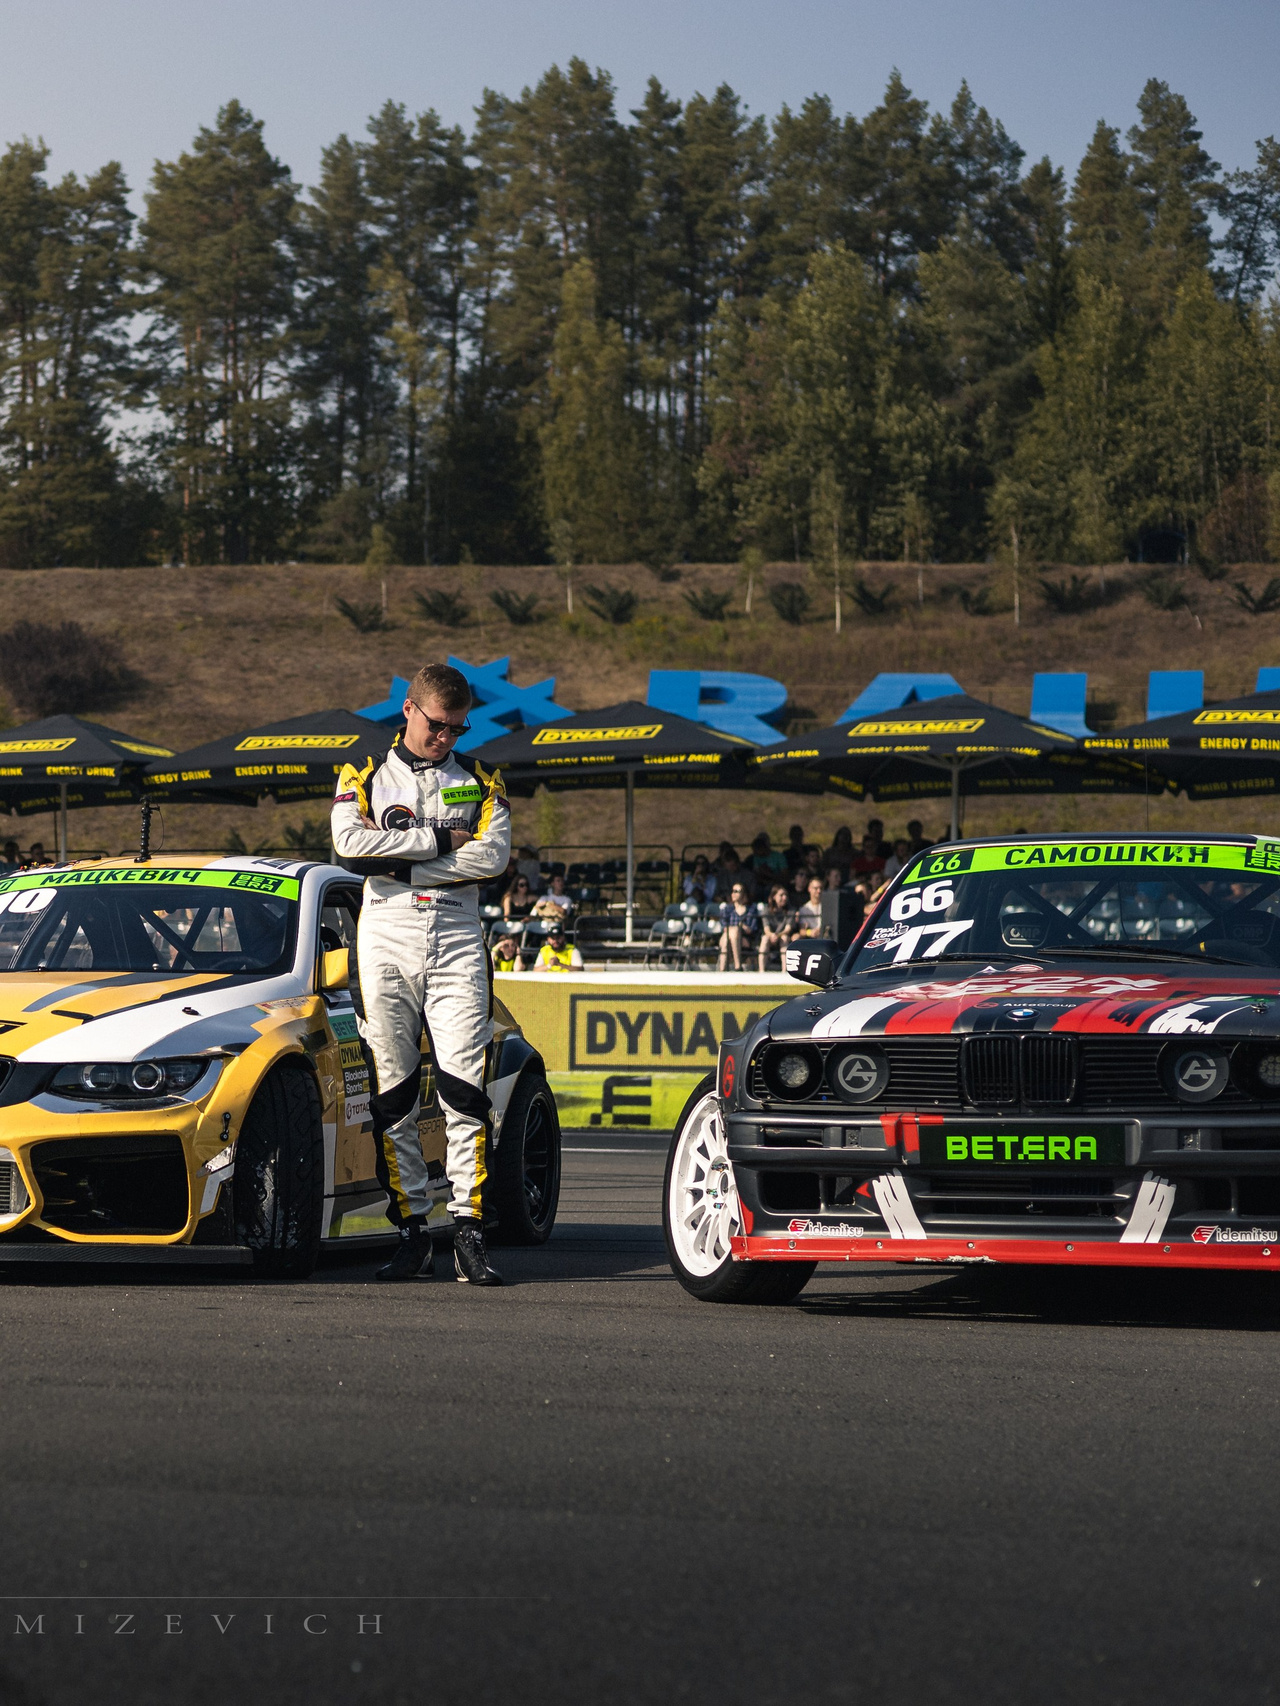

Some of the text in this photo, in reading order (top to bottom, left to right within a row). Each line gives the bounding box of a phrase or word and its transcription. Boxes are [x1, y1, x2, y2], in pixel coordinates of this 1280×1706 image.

[1133, 738, 1170, 748] DRINK
[1200, 738, 1280, 751] ENERGY DRIN
[45, 766, 116, 777] ENERGY DRINK
[143, 769, 212, 786] ENERGY DRINK
[235, 764, 308, 776] ENERGY DRINK
[929, 853, 961, 874] 66
[1004, 845, 1211, 866] САМОШКИН
[40, 869, 202, 887] МАЦКЕВИЧ
[889, 880, 955, 922] 66
[883, 919, 975, 966] 17
[1003, 1002, 1077, 1010] AutoGroup
[586, 1011, 761, 1055] DYNAM
[808, 1222, 864, 1238] idemitsu
[1216, 1227, 1278, 1242] idemitsu
